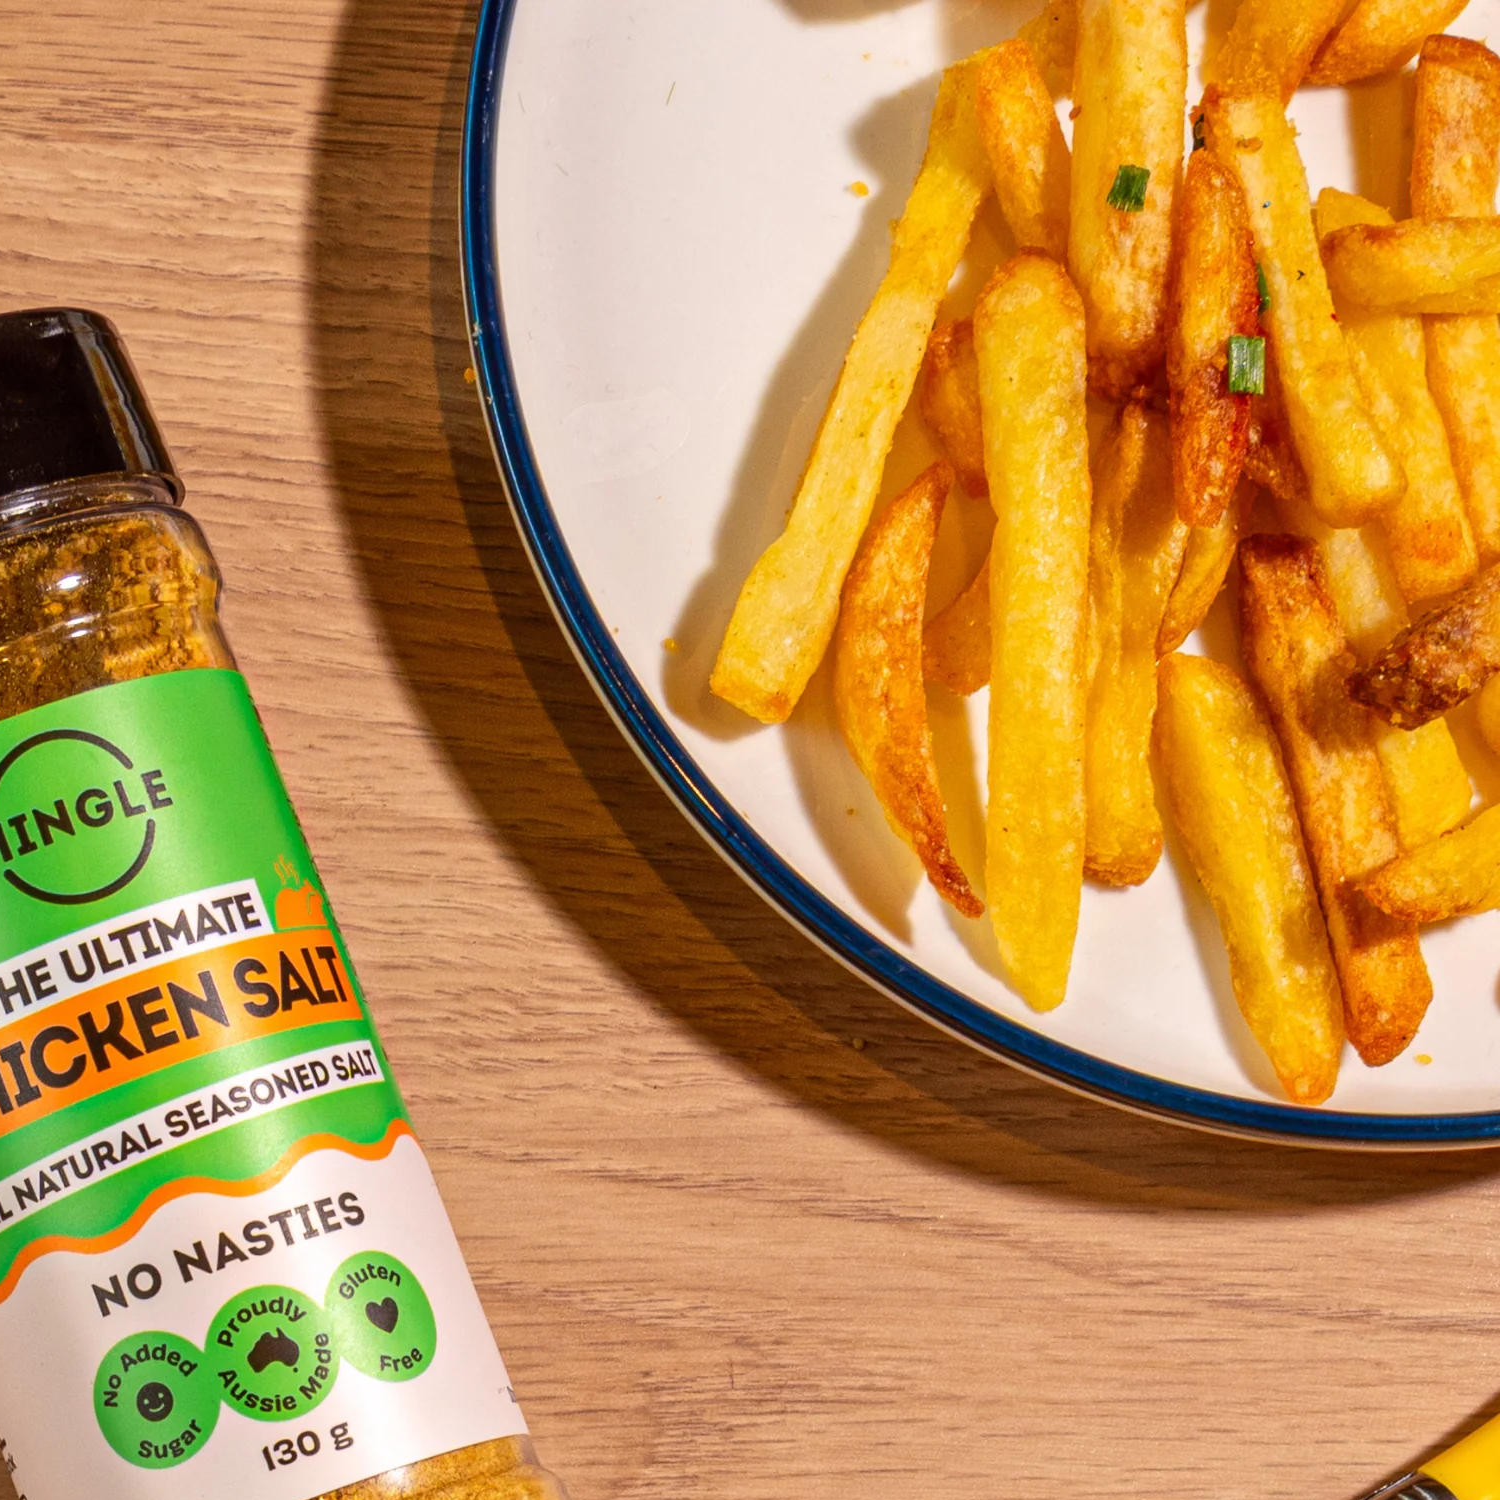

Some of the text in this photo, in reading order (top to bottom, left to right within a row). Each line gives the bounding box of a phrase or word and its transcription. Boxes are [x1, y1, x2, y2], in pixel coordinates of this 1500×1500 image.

[59, 892, 262, 983] ULTIMATE
[236, 945, 348, 1017] SALT
[12, 1123, 162, 1211] NATURAL
[163, 1060, 329, 1138] SEASONED
[334, 1048, 376, 1080] SALT
[90, 1191, 366, 1317] NO NASTIES
[339, 1262, 402, 1299] Gluten
[217, 1296, 307, 1348] Proudly
[103, 1343, 198, 1408] No Added
[217, 1331, 330, 1413] Aussie Made
[379, 1347, 424, 1372] Free
[138, 1418, 203, 1459] Sugar
[262, 1421, 355, 1472] 130 g
